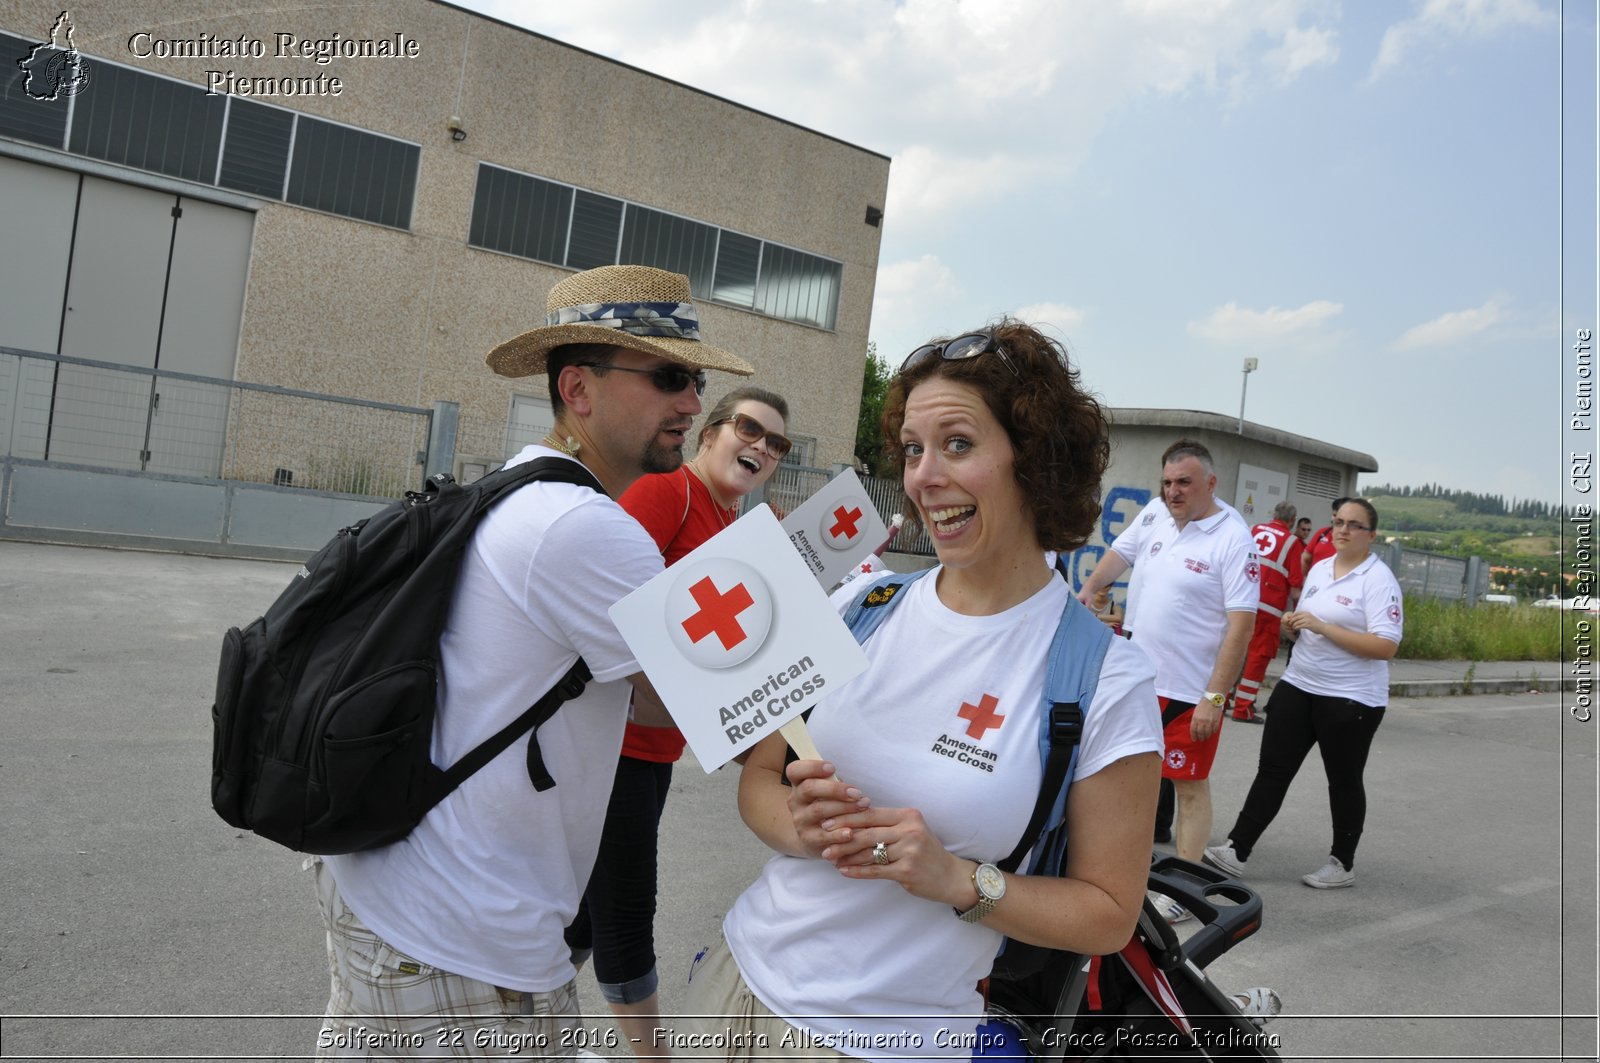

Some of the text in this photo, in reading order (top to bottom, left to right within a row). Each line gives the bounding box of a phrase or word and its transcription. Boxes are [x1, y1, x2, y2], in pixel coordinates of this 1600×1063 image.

[795, 529, 825, 573] American
[719, 656, 814, 726] American
[725, 674, 826, 745] Red Cross
[931, 743, 994, 773] Red Cross
[937, 734, 998, 761] American
